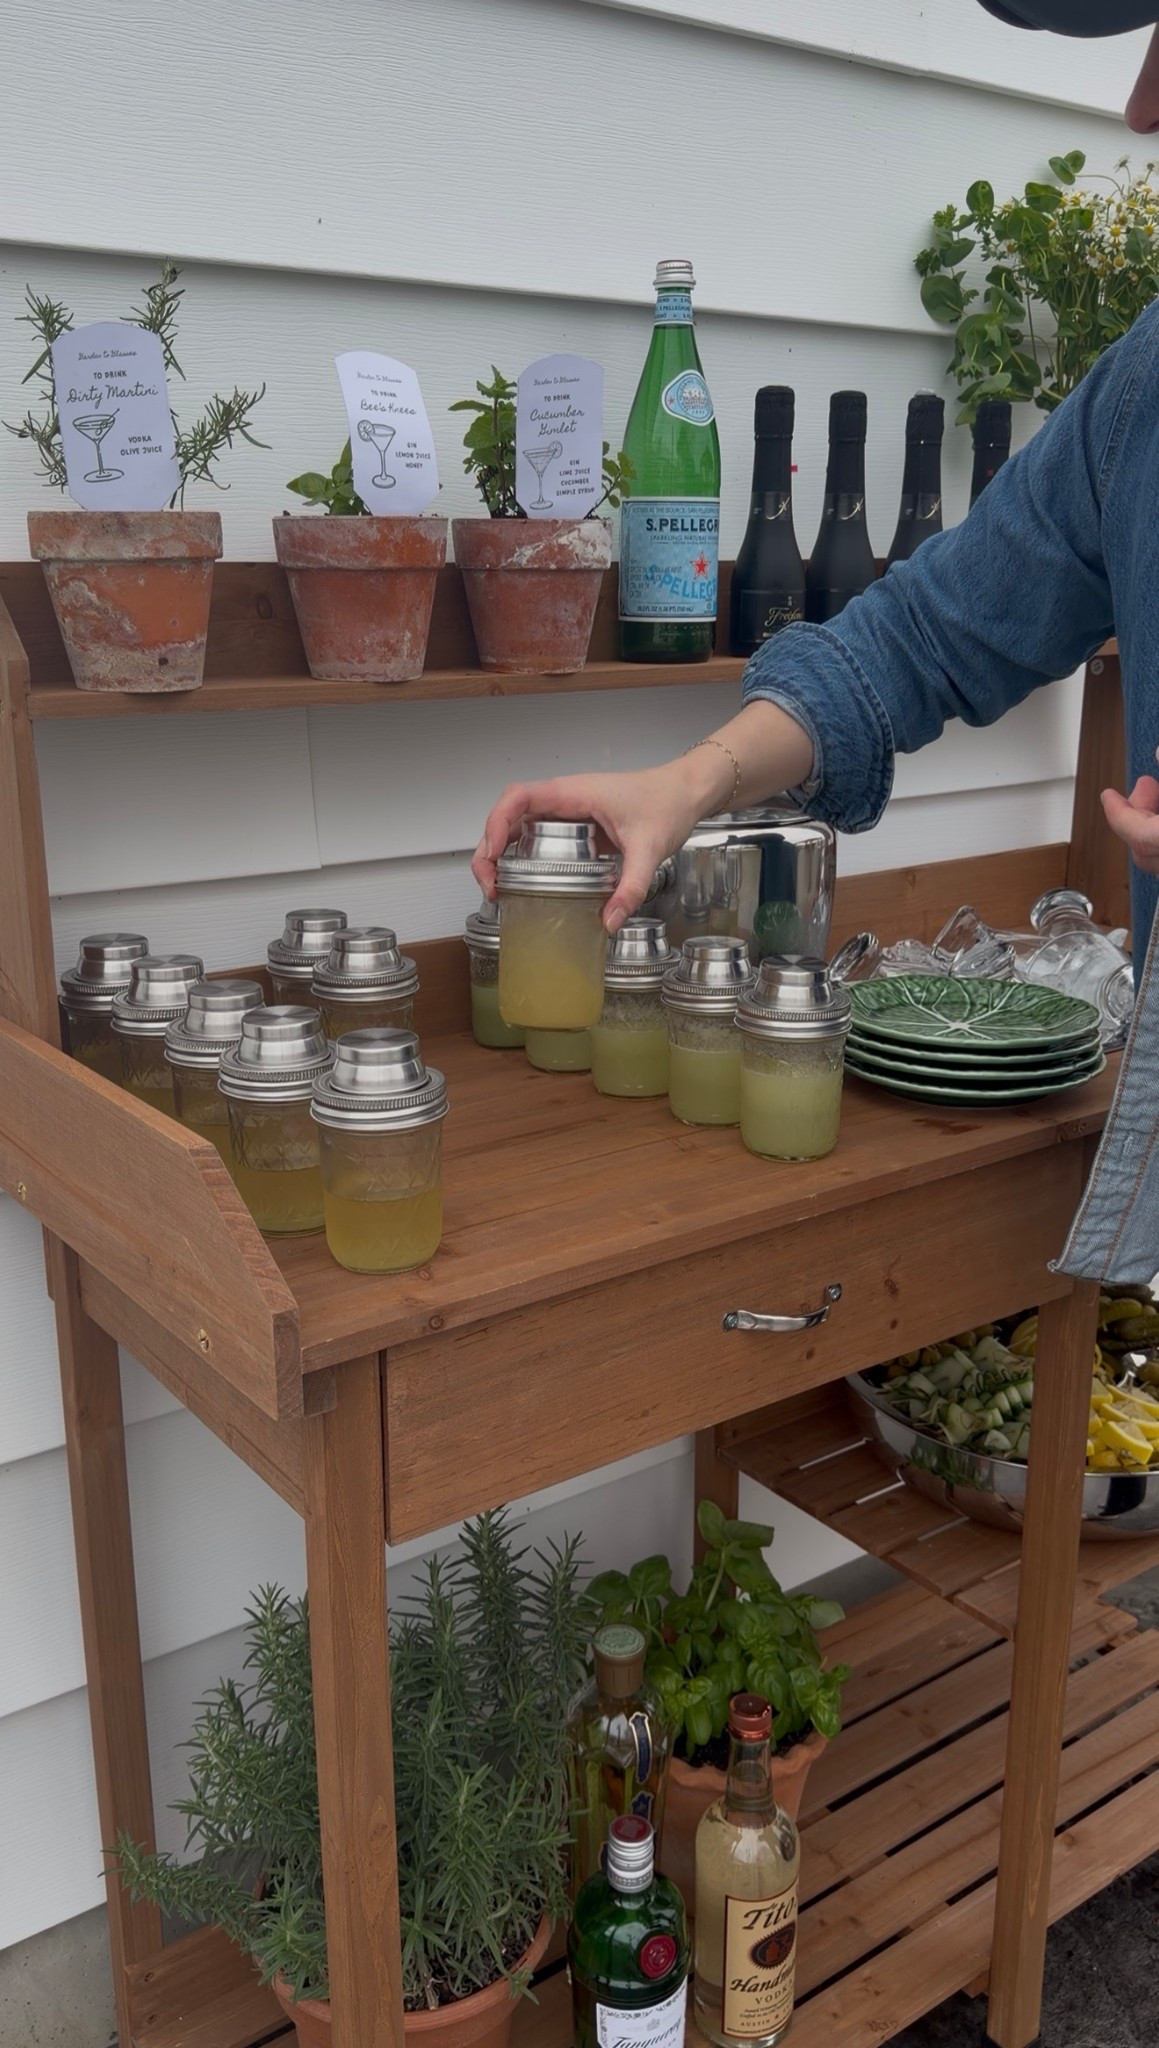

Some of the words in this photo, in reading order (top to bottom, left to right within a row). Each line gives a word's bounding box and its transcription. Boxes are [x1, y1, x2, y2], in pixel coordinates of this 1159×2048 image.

[93, 371, 103, 380] TO
[105, 370, 128, 379] DRINK
[67, 385, 103, 409] Dirty
[105, 381, 159, 400] Martini
[371, 389, 379, 397] TO
[380, 390, 398, 399] DRINK
[553, 393, 571, 402] DRINK
[360, 399, 387, 413] Bee's
[388, 403, 417, 416] Knees
[530, 405, 585, 422] Cucumber
[537, 420, 578, 438] Gimlet
[128, 435, 153, 444] VODKA
[120, 447, 140, 457] OLIVE
[142, 445, 163, 454] JUICE
[395, 451, 414, 459] LEMON
[416, 452, 432, 461] JUICE
[405, 462, 424, 470] HONEY
[559, 469, 573, 477] LIME
[574, 467, 591, 475] JUICE
[560, 478, 590, 486] CUCUMBER
[556, 488, 576, 497] SIMPLE
[577, 486, 595, 495] SYRUP
